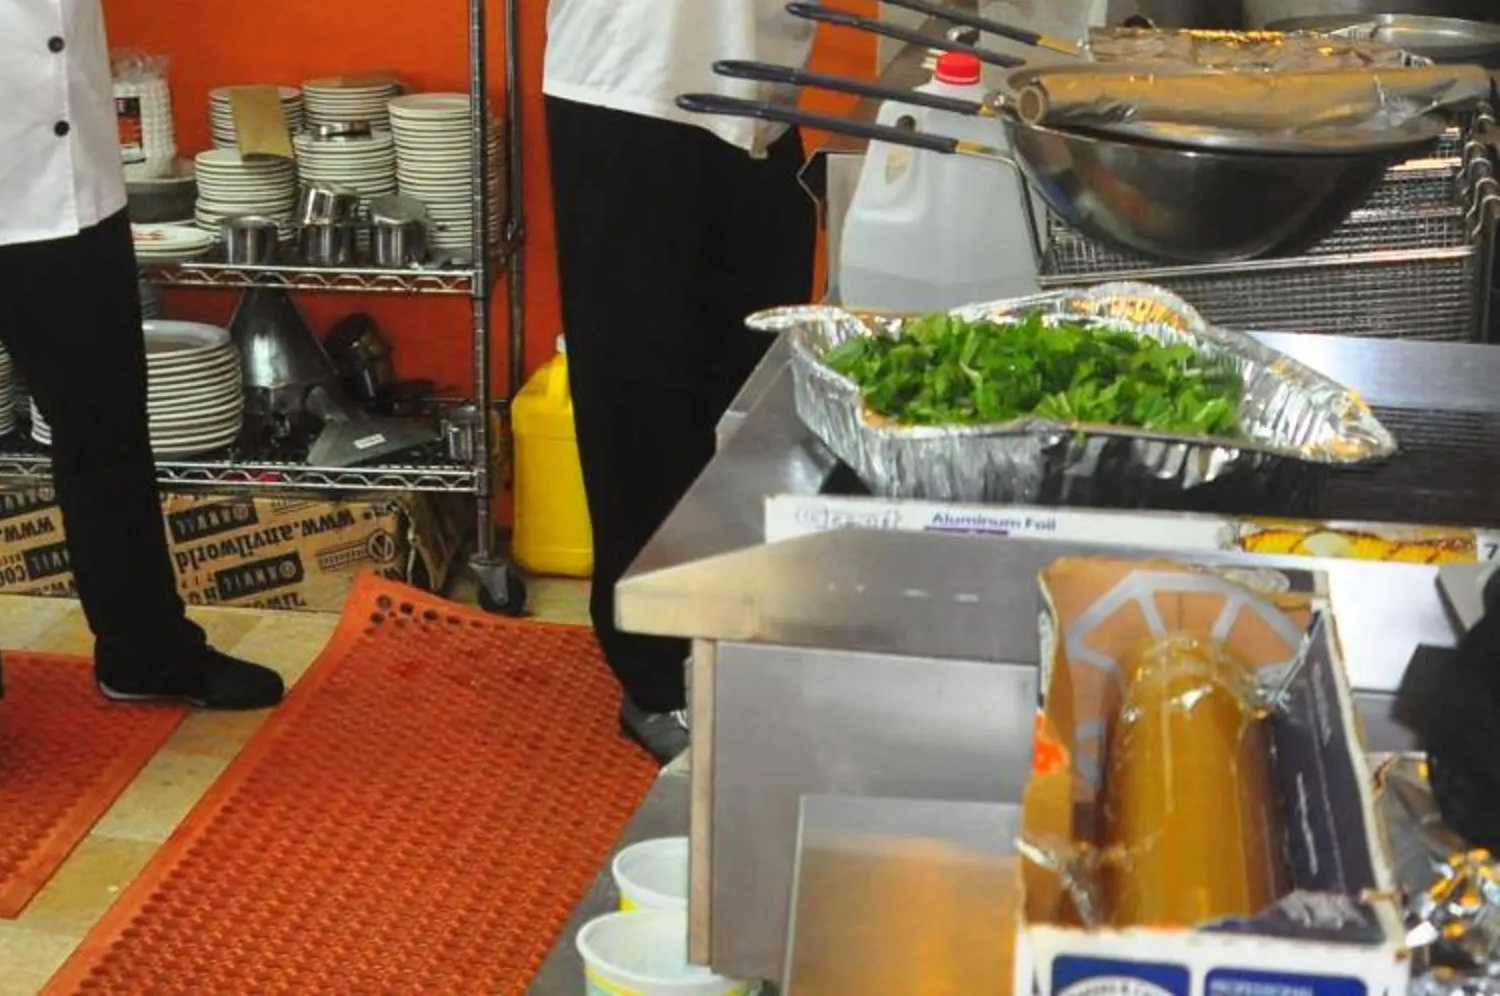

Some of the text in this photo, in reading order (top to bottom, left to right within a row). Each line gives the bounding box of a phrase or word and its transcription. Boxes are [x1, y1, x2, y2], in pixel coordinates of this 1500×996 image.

[175, 508, 232, 535] ANVIL
[931, 512, 1057, 531] Aluminum Foil
[221, 565, 278, 592] ANVIL
